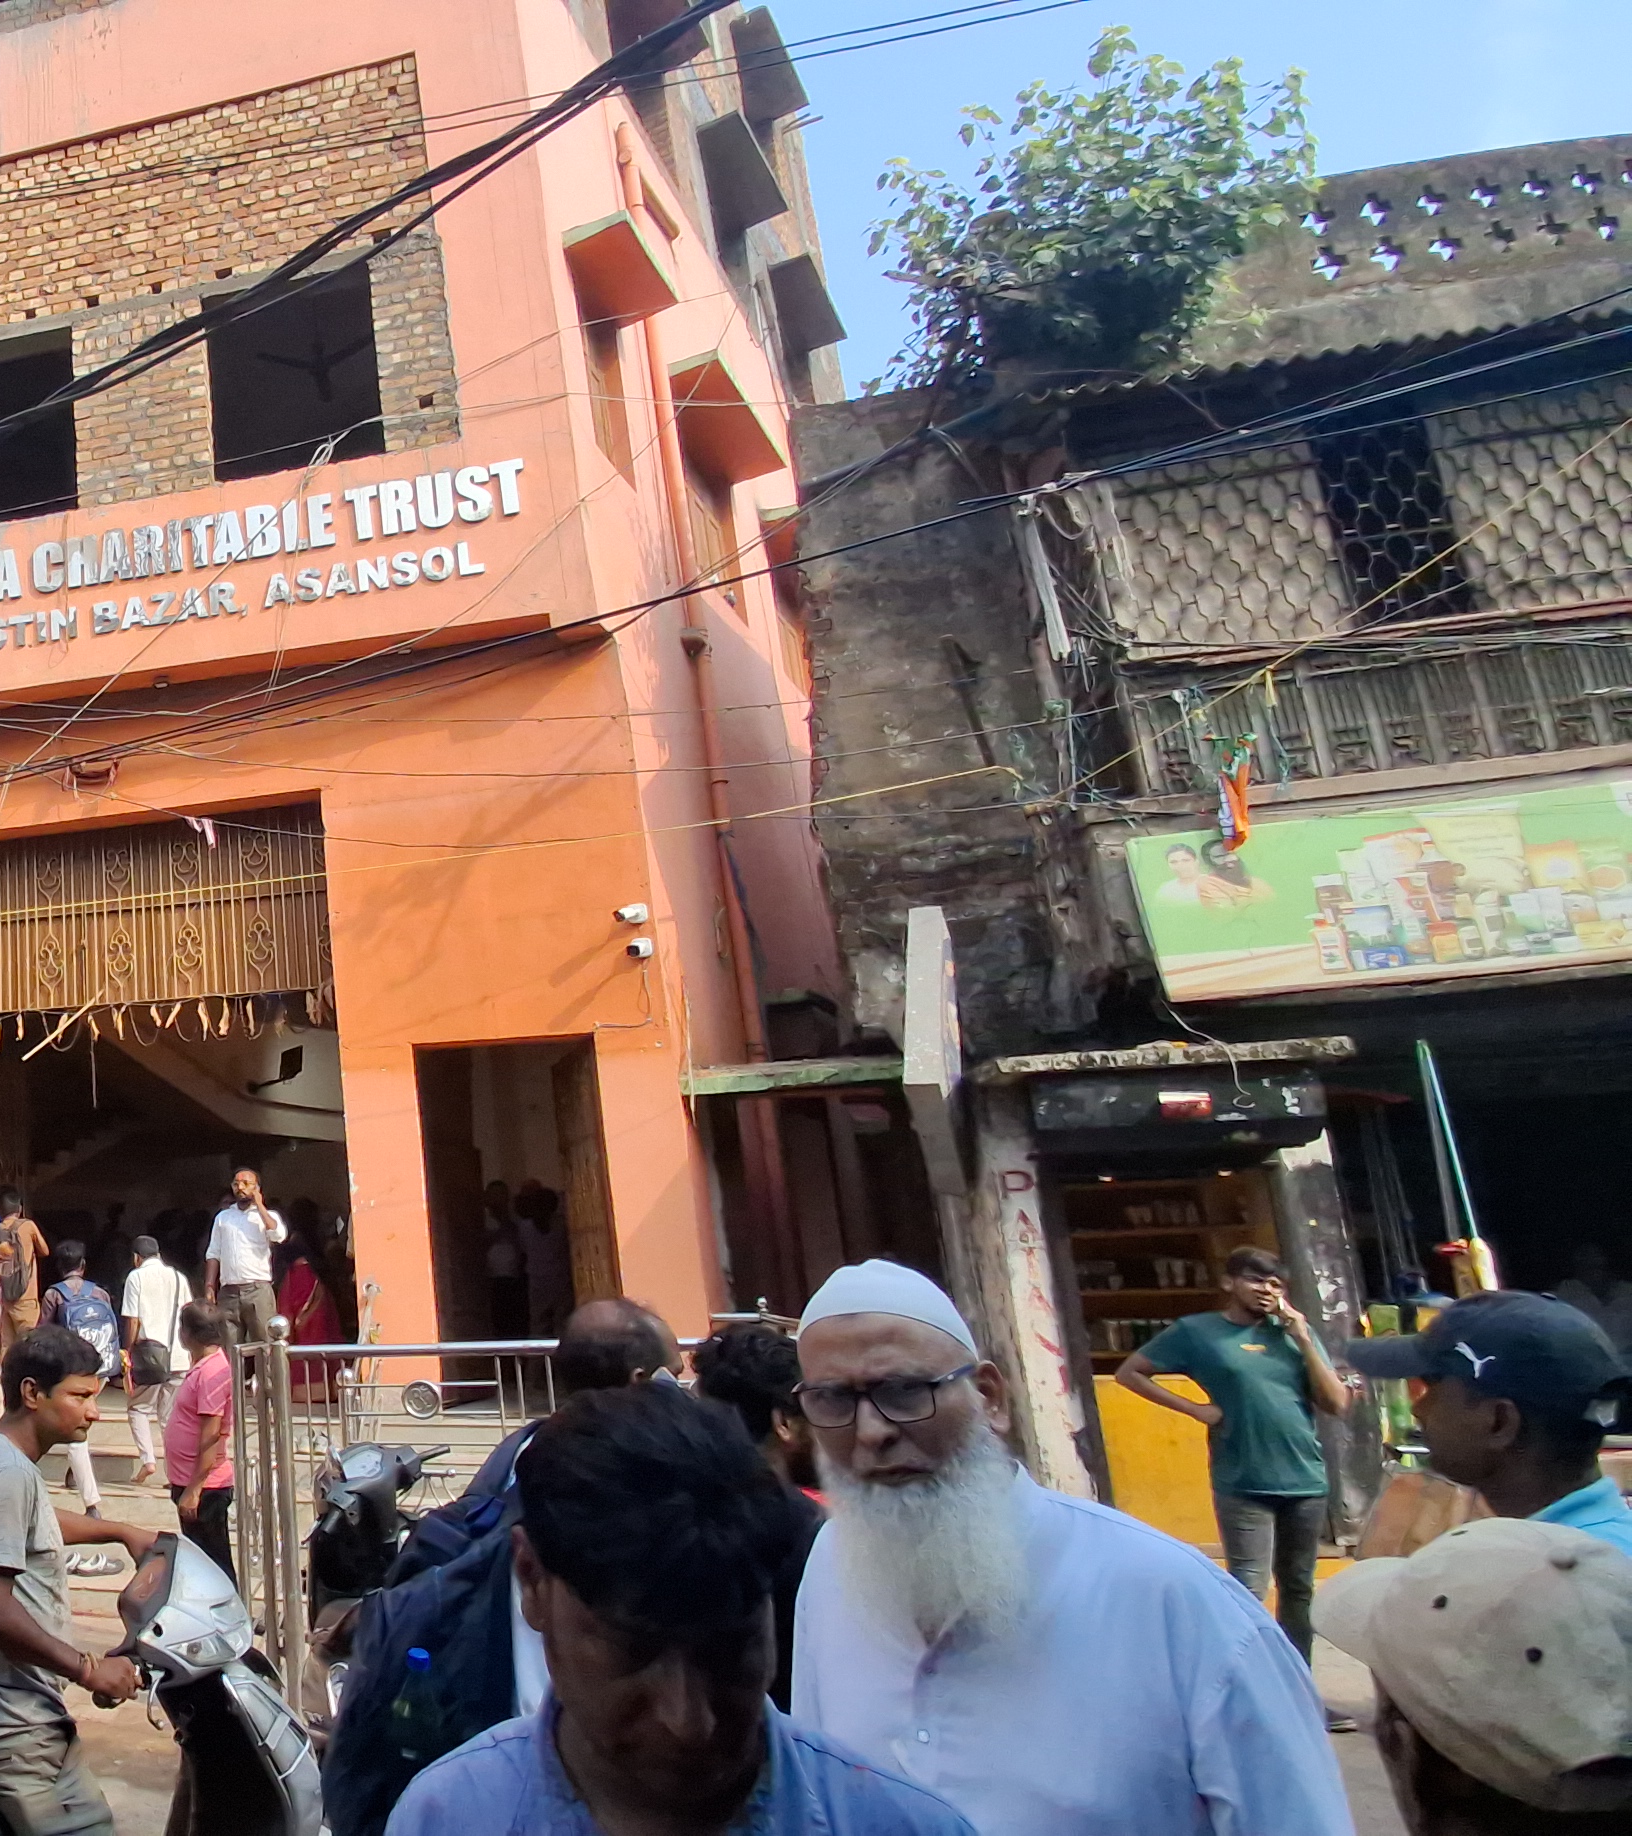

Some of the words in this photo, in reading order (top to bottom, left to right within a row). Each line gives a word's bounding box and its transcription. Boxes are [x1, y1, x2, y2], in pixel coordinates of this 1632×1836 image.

[32, 493, 336, 592] CHARITABLE
[345, 458, 524, 541] TRUST
[93, 582, 248, 635] BAZAR,
[264, 542, 485, 608] ASANSOL
